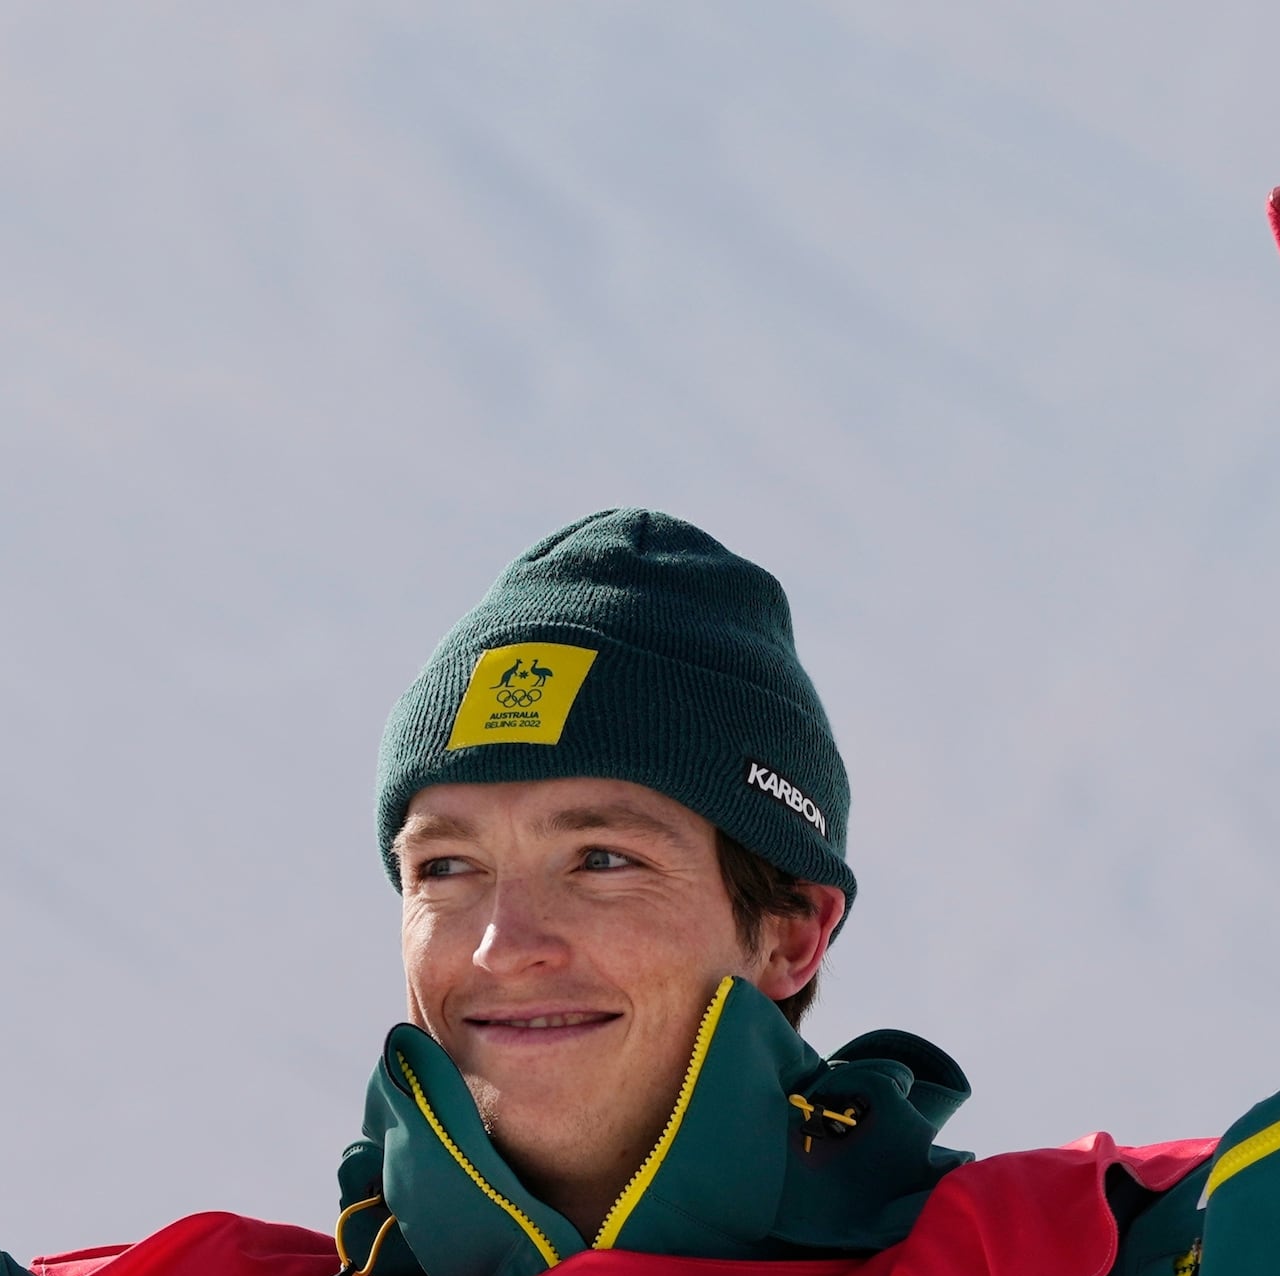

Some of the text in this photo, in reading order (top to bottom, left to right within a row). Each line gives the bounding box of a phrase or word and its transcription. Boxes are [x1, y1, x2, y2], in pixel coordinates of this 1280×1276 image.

[489, 711, 539, 720] AUSTRALIA
[484, 719, 541, 729] BEIJING 2022
[747, 762, 826, 837] KARBON
